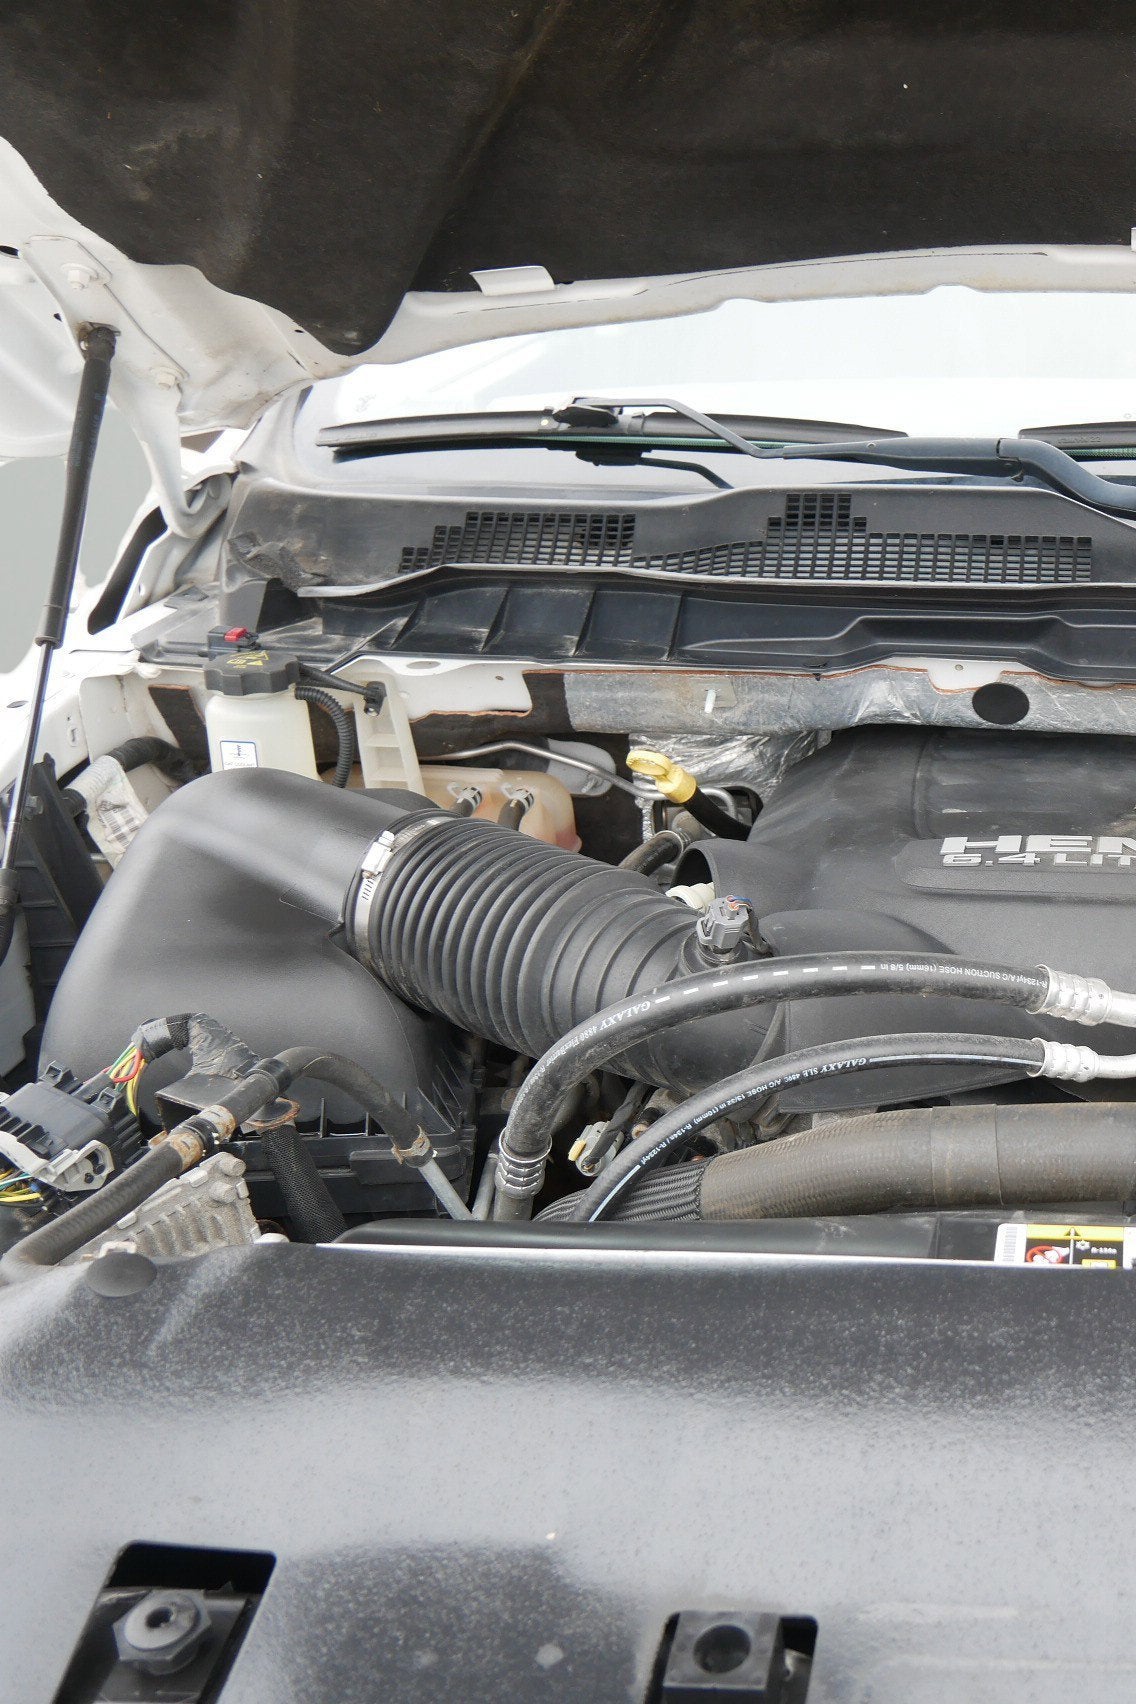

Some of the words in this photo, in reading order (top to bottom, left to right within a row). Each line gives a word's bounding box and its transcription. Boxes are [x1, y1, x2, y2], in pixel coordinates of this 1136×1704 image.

[942, 853, 1041, 867] 6.4
[890, 963, 904, 971] 5/8
[906, 963, 937, 973] (16mm)
[939, 965, 963, 975] HOSE
[964, 968, 1001, 980] SUCTION
[1002, 974, 1015, 983] A/C
[600, 1001, 651, 1030] GALAXY
[820, 1057, 867, 1073] GALAXY
[802, 1066, 819, 1078] SLE
[769, 1078, 781, 1088] A/C
[748, 1083, 768, 1096] HOSE
[726, 1093, 746, 1106] 13/32
[693, 1107, 720, 1125] (10mm)
